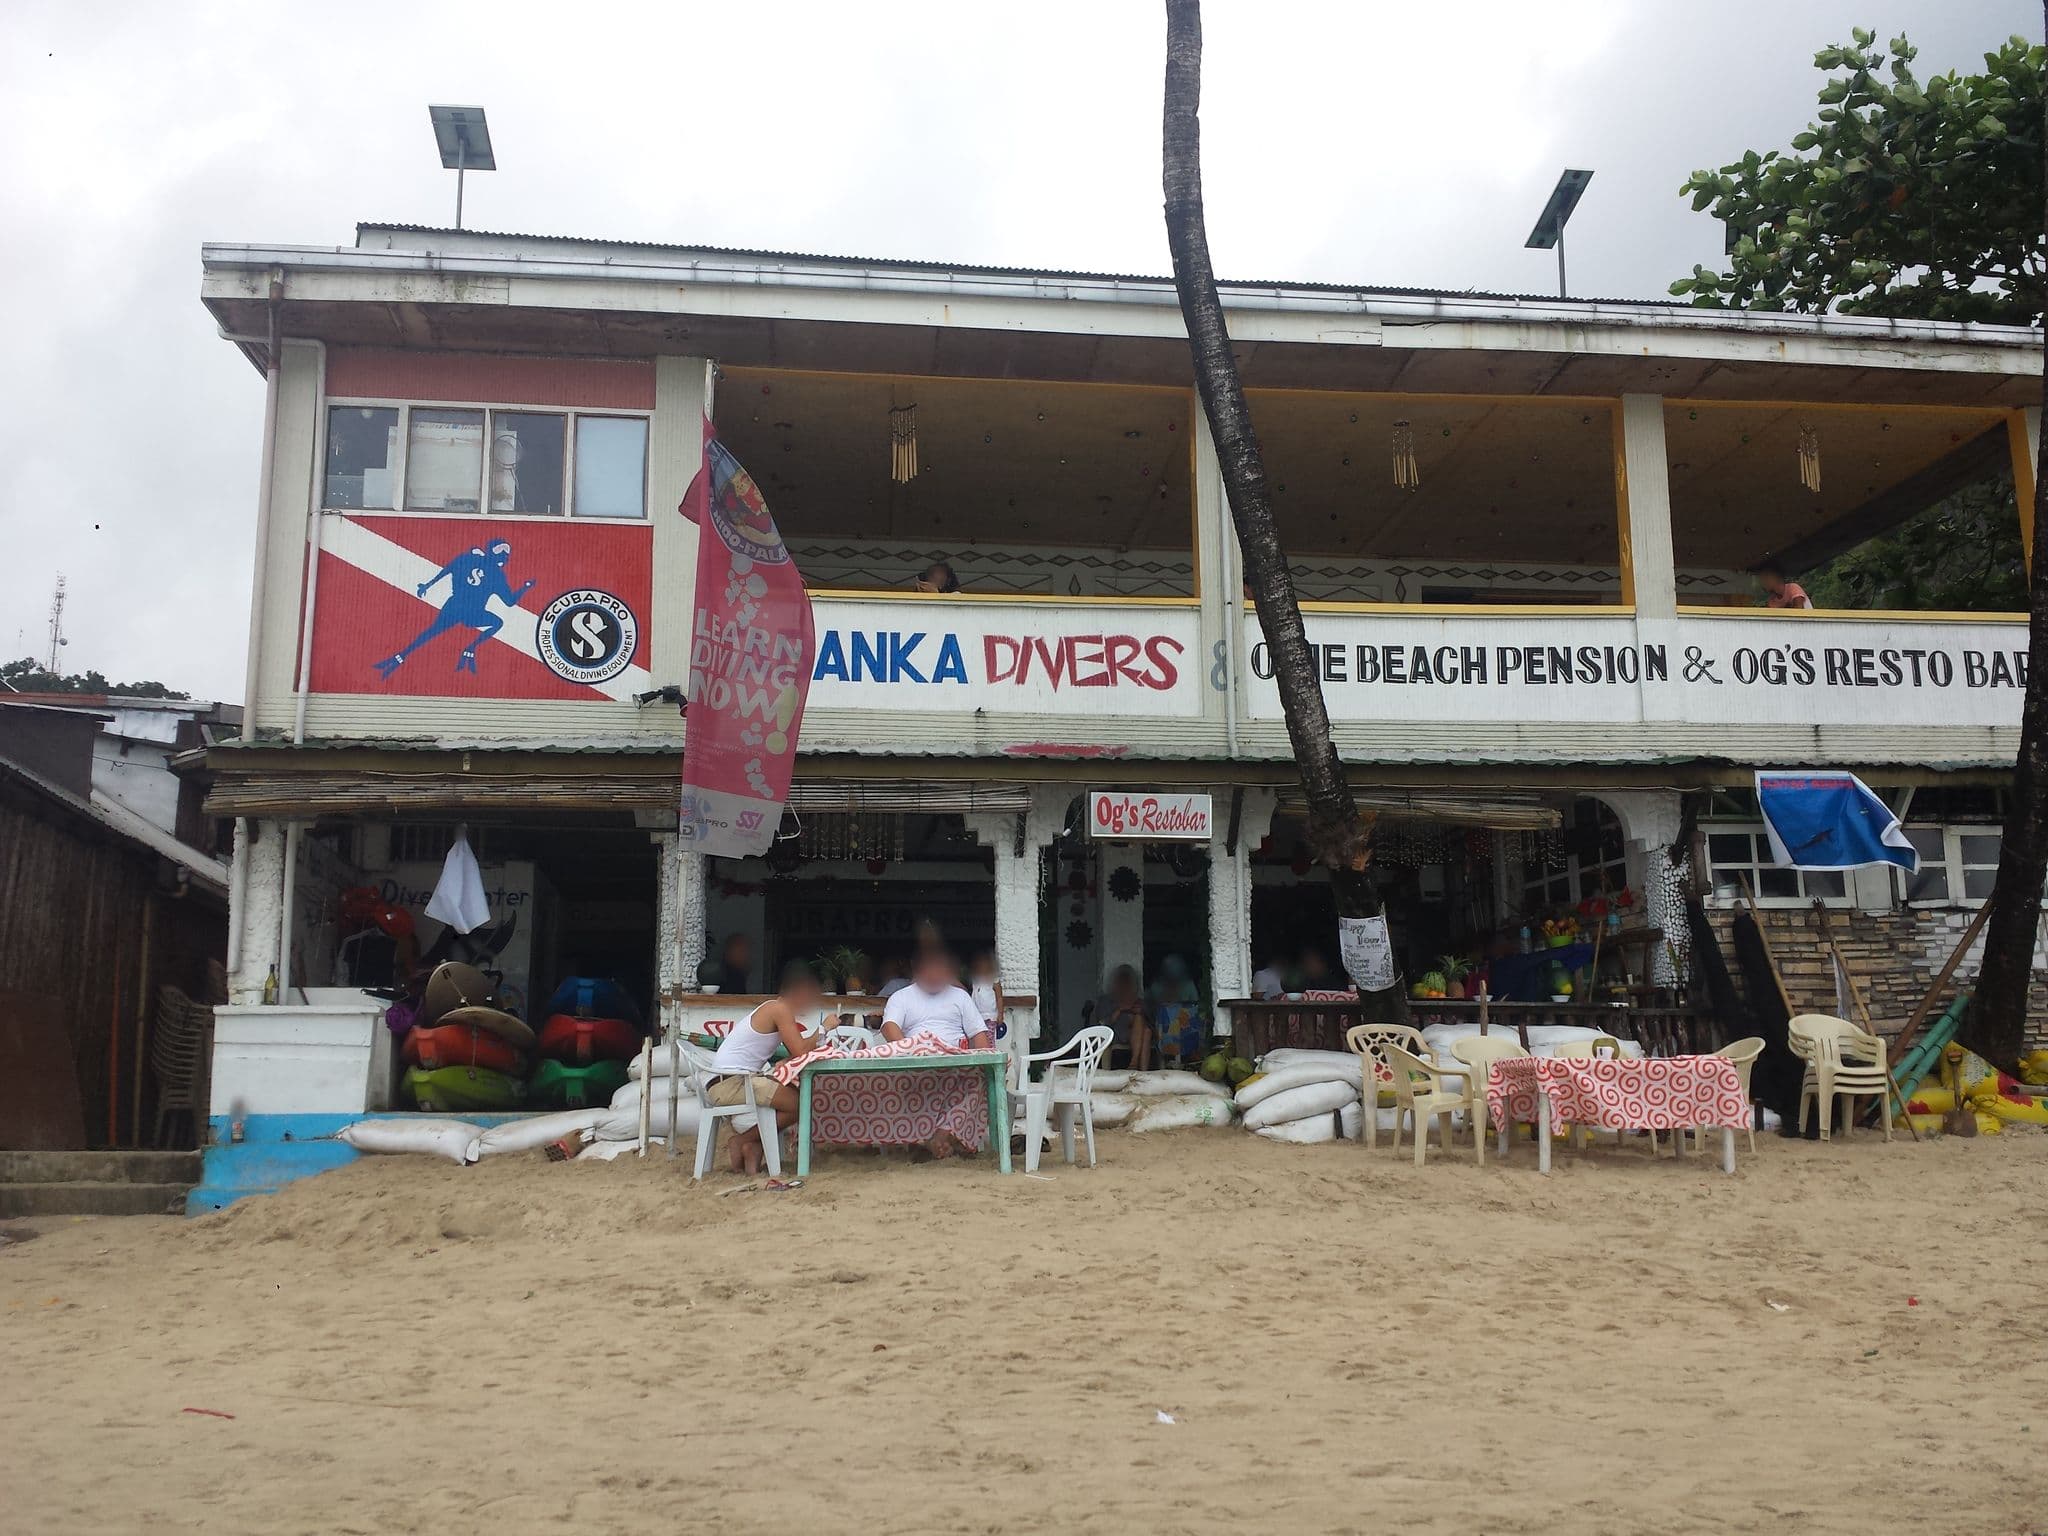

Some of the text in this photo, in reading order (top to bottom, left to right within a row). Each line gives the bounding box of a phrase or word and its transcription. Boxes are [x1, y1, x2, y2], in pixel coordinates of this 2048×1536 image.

[545, 592, 629, 625] SCUBAPRO
[540, 629, 633, 680] PROFESSIONAL DIVING EQUIPMENT
[696, 607, 803, 664] LEARN
[690, 638, 798, 692] DIVING
[983, 634, 1185, 693] DIVERS
[1356, 644, 1488, 685] BEACH
[1496, 644, 1668, 685] PENSION
[1682, 645, 1723, 685] &
[1732, 643, 1816, 686] OG'S
[1823, 648, 1953, 688] RESTO
[1096, 795, 1207, 834] Og's Restobar
